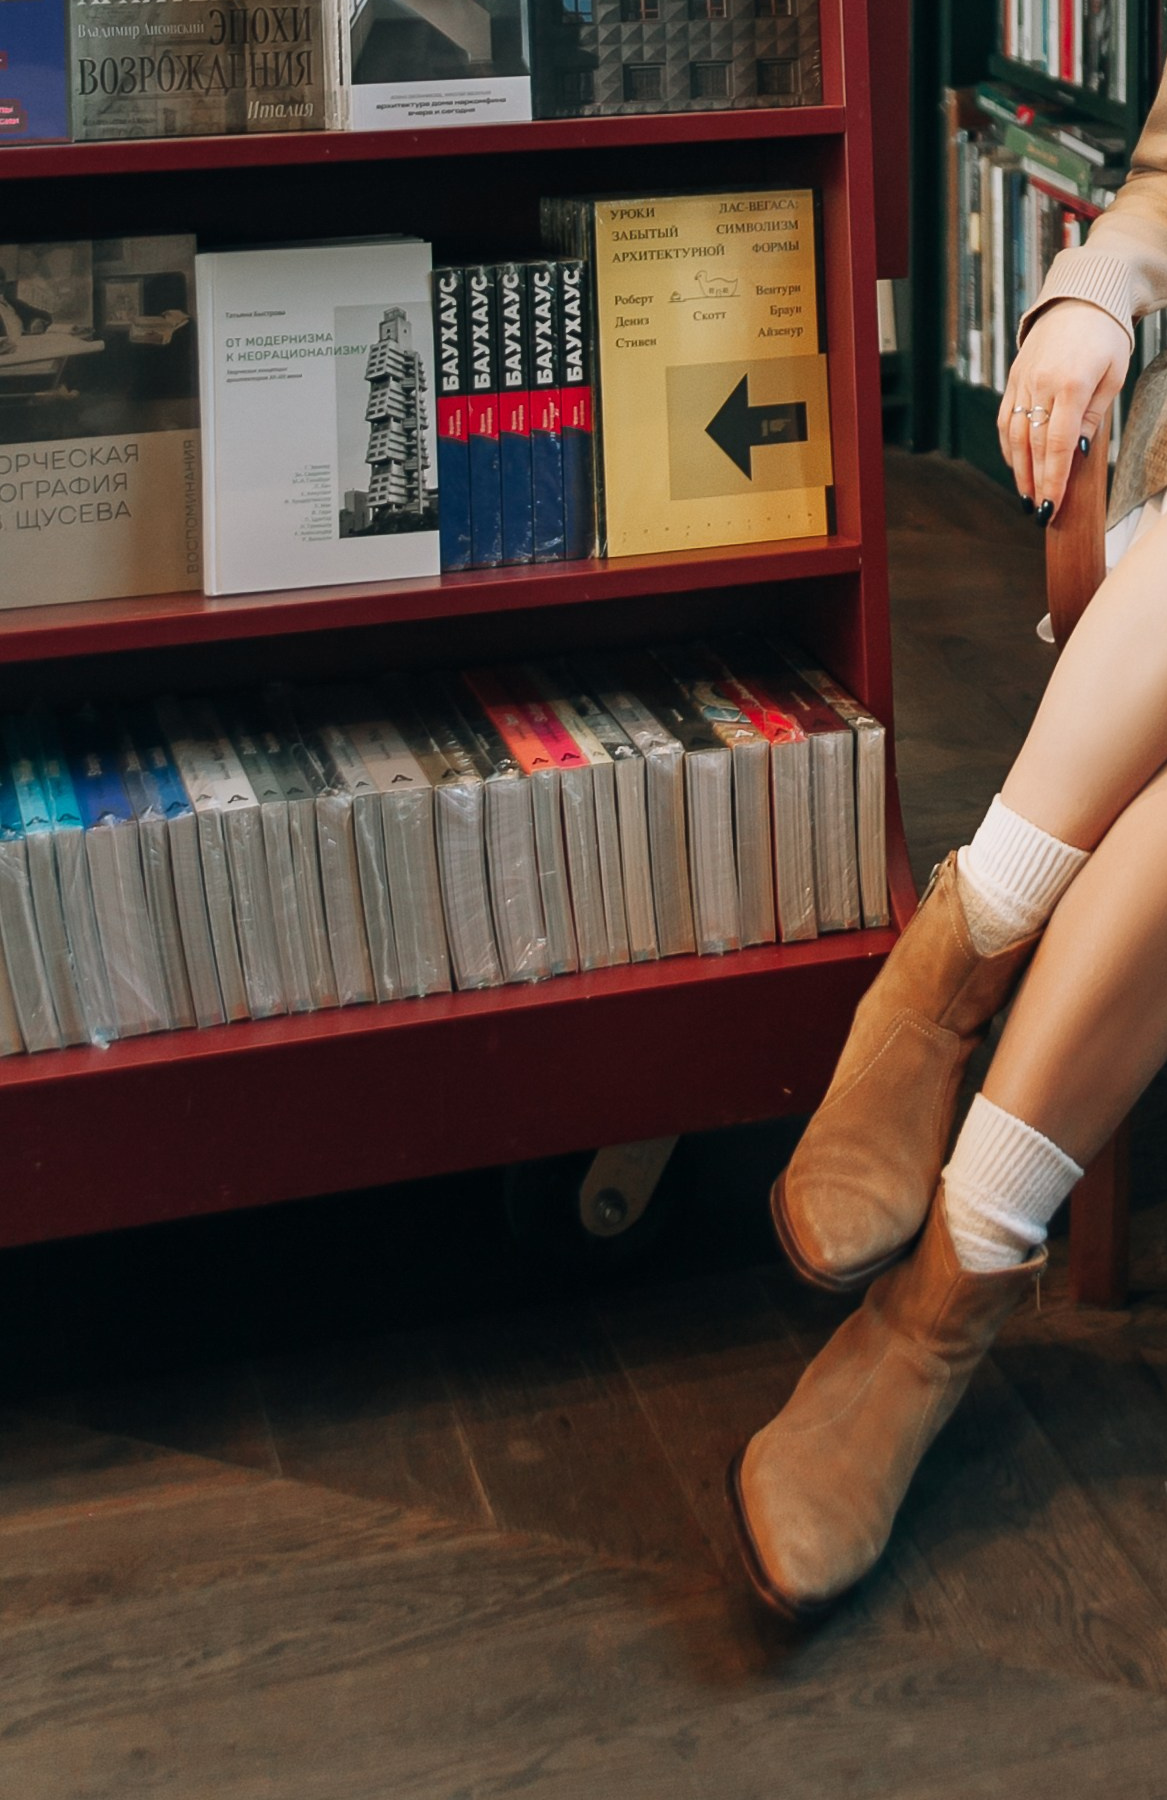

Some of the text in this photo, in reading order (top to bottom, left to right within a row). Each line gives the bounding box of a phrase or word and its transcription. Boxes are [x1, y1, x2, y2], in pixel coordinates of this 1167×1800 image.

[78, 23, 140, 40] Владимир
[208, 6, 312, 46] ЭПОХИ
[78, 50, 313, 96] ВОЗРОЖДЕНИЯ
[247, 100, 314, 120] Италия
[376, 100, 430, 110] архитектура
[408, 109, 433, 117] вчера
[441, 107, 475, 116] сегодня
[610, 207, 655, 221] УРОКИ
[612, 220, 799, 242] ЗАБЫТЫЙ СИМВОЛИЗМ
[612, 240, 800, 264] АРХИТЕКТУРНОЙ ФОРМЫ
[614, 284, 801, 306] Роберт Вентури
[534, 271, 554, 385] БАУХАУС
[563, 269, 583, 382] БАУХАУС
[615, 304, 802, 329] Дениз Скотт Браун
[225, 333, 334, 348] ОТ МОДЕРНИЗМА
[439, 275, 460, 391] БАУХАУС
[471, 274, 491, 389] БАУХАУС
[502, 272, 522, 387] БАУХАУС
[615, 326, 804, 349] Стивен Айзенур
[226, 345, 368, 362] К НЕОРАЦИОНАЛИЗМУ
[0, 443, 140, 475] ОРЧЕСКАЯ
[0, 472, 128, 503] ОГРАФИЯ
[17, 500, 132, 531] ЩУСЕВА
[183, 440, 200, 574] ВОСПОМИНАНИЯ
